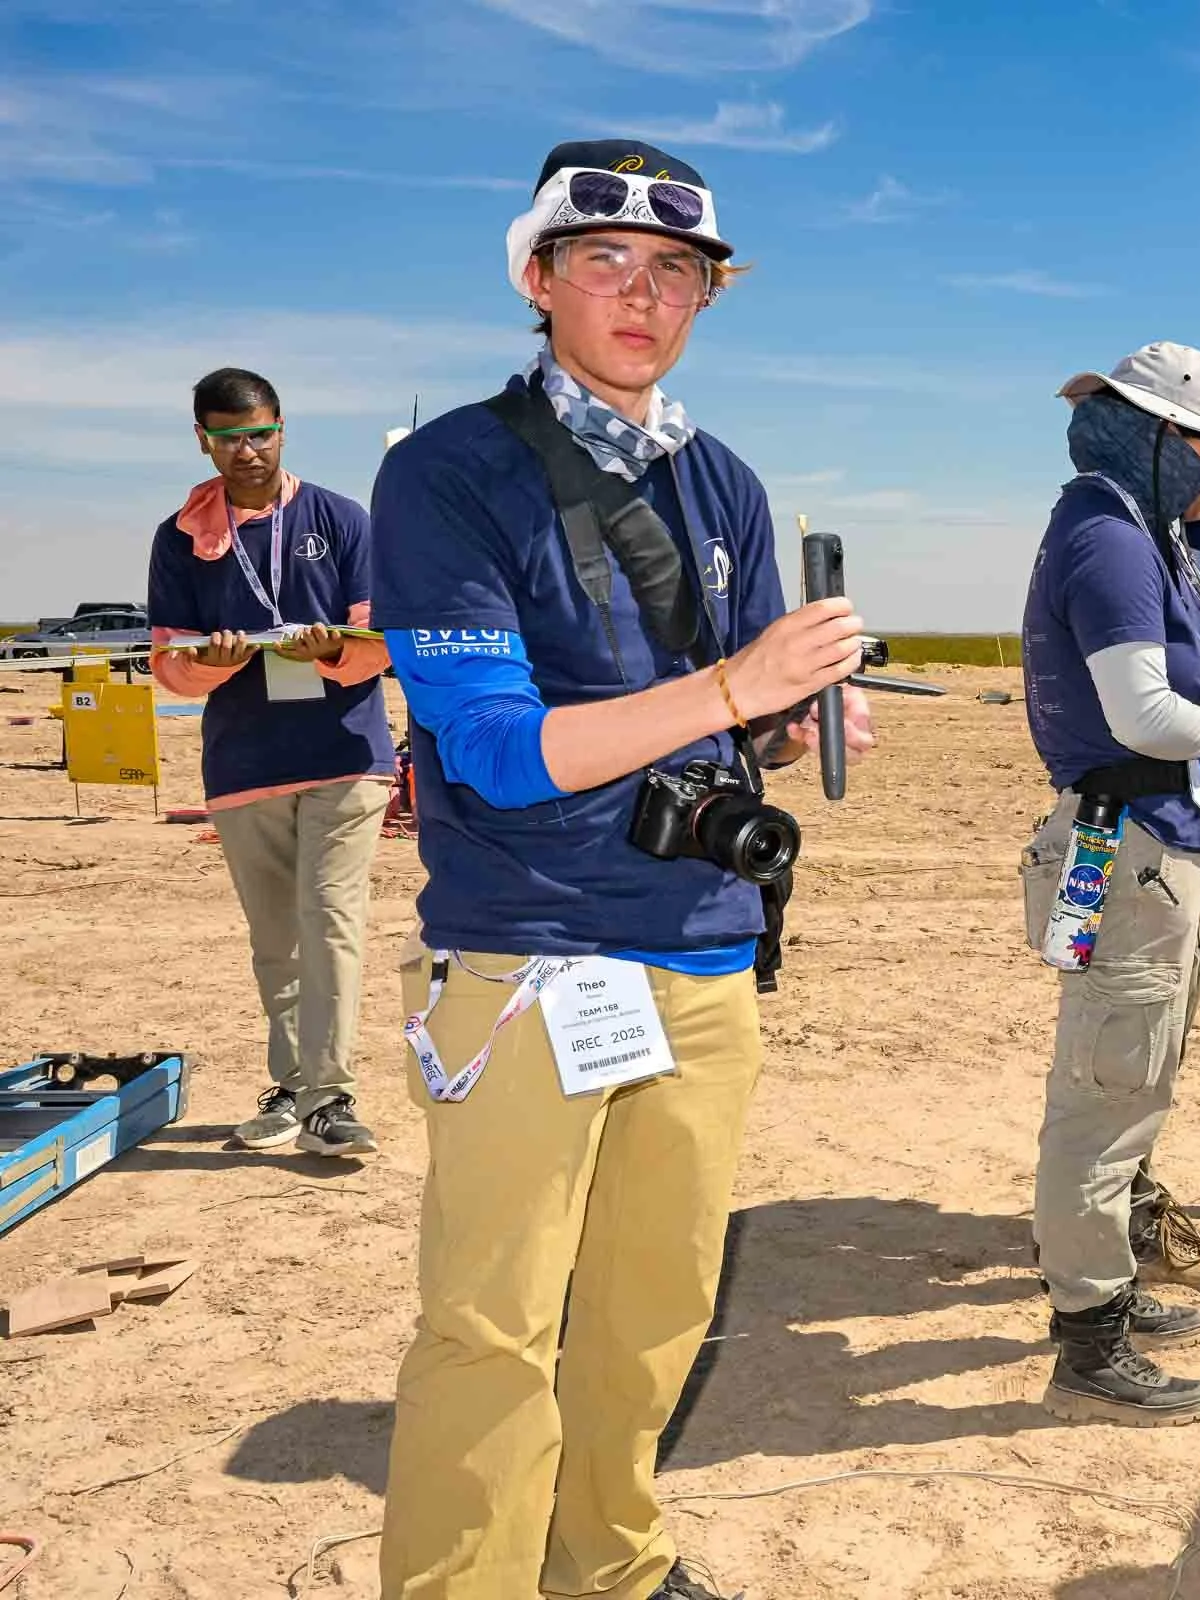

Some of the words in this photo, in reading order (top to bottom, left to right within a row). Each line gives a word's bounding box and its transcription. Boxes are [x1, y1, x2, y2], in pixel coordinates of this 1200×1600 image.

[416, 646, 511, 657] FOUNDATION
[75, 696, 91, 706] B2
[719, 776, 740, 785] SONY
[1068, 877, 1101, 894] NASA
[576, 979, 606, 993] Theo
[578, 1007, 602, 1018] TEAM
[603, 1003, 619, 1013] 168
[571, 1035, 603, 1052] IREC
[610, 1025, 645, 1044] 2025
